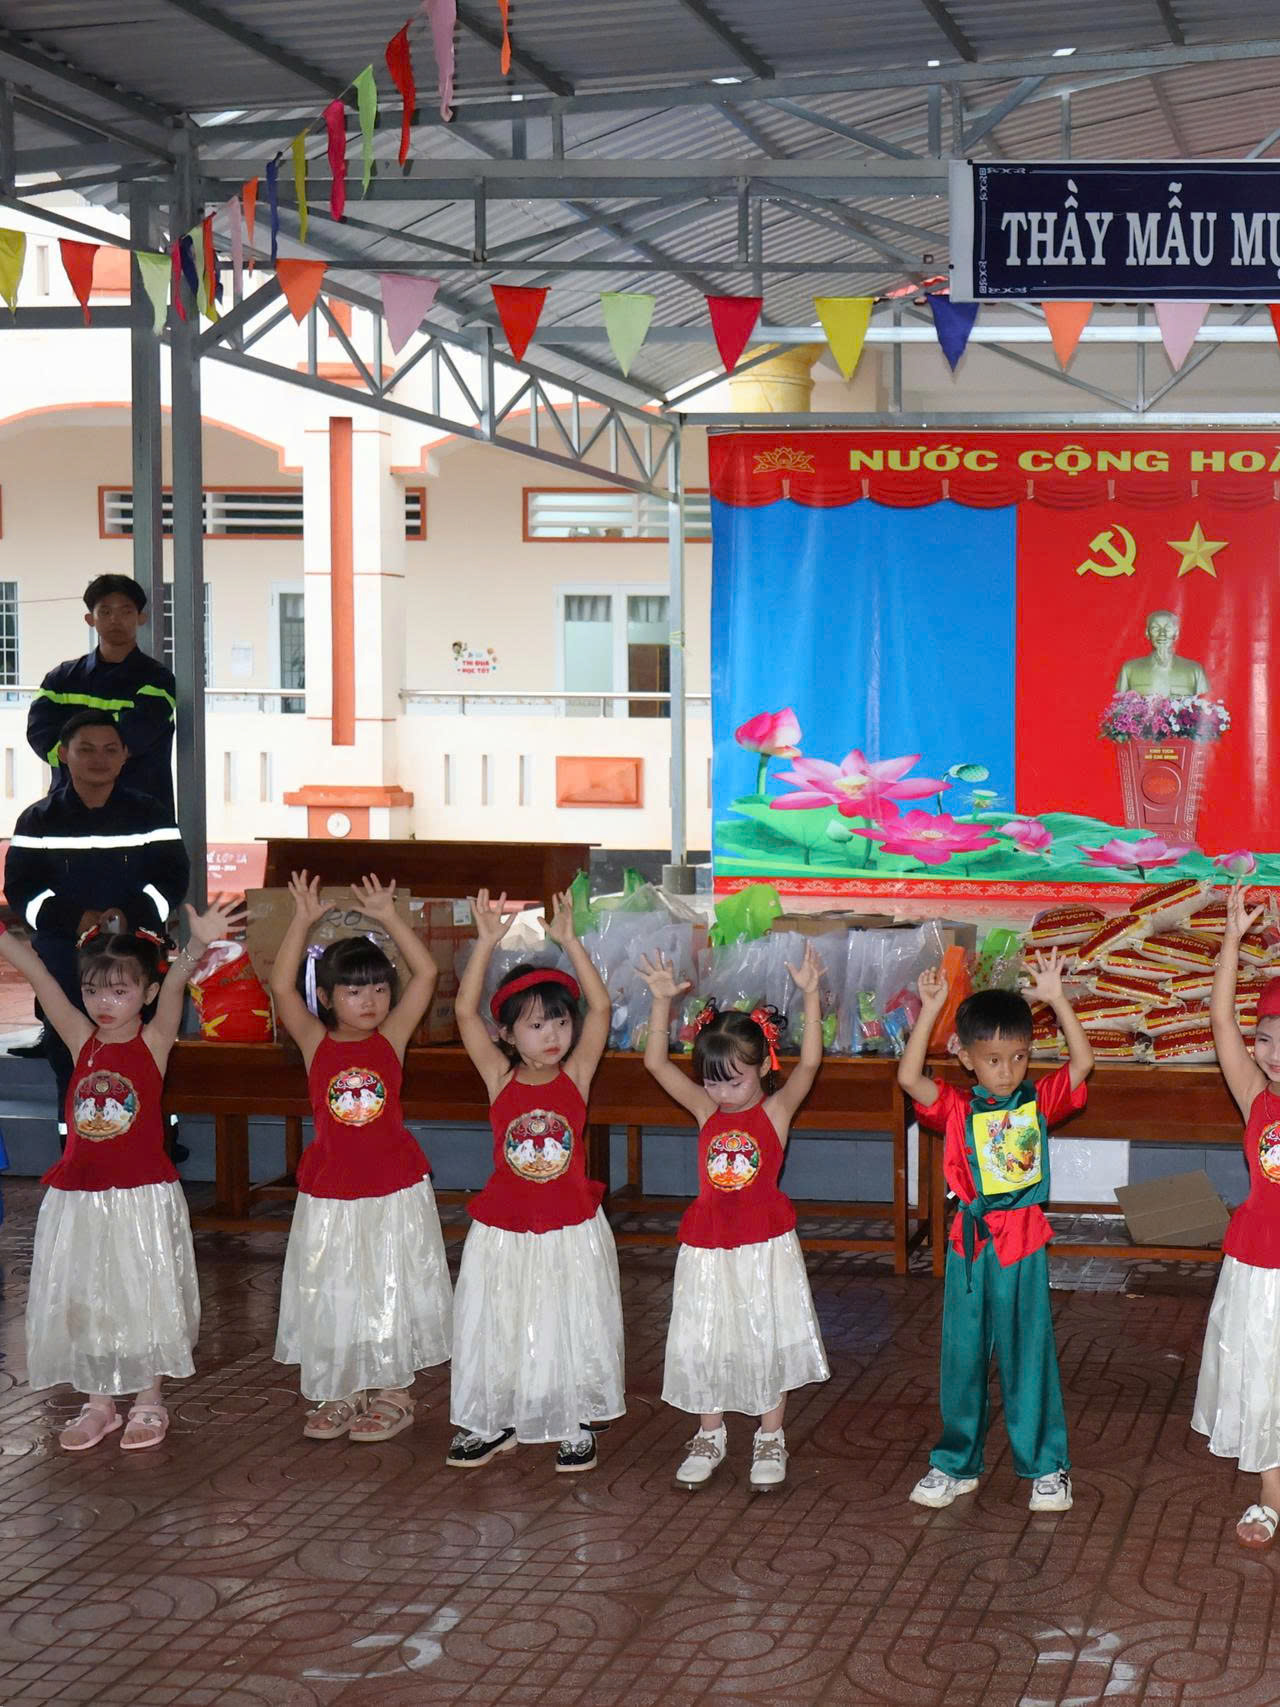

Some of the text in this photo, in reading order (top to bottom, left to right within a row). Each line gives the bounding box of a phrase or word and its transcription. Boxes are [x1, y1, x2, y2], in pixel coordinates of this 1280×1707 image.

[1001, 179, 1114, 267] THẦY
[1126, 182, 1217, 267] MẪU
[850, 445, 998, 472] NƯỚC
[1018, 445, 1169, 476] CỘNG
[1161, 1027, 1212, 1041] CAMPUCHI
